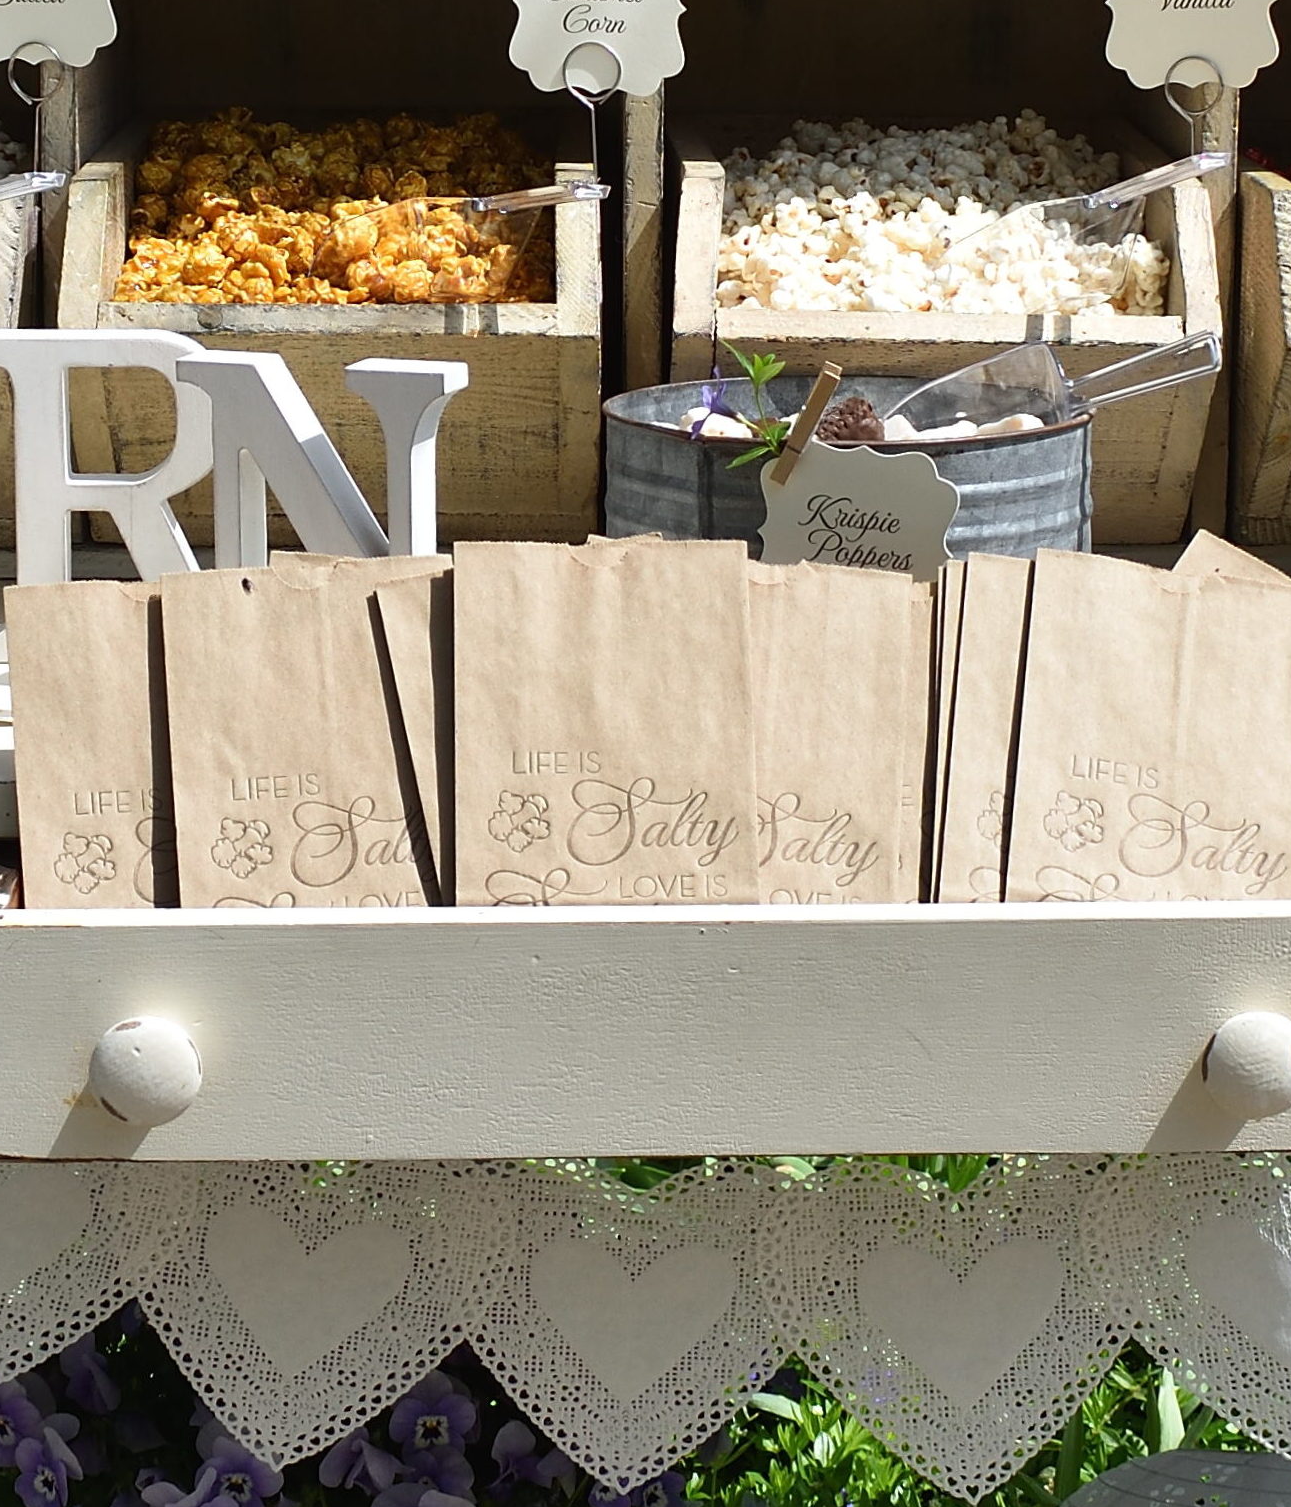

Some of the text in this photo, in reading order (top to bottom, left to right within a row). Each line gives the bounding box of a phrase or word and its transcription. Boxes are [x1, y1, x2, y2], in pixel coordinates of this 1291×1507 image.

[563, 4, 627, 34] Corn
[798, 494, 901, 543] Krispie
[805, 529, 914, 571] Poppers
[512, 751, 602, 775] LIFE IS
[1072, 754, 1160, 789] LIFE IS
[74, 788, 163, 816] LIFE IS
[231, 773, 321, 802] LIFE IS
[566, 776, 740, 867] Salty
[1118, 793, 1287, 895] Salty
[619, 875, 696, 899] LOVE
[706, 875, 728, 899] IS
